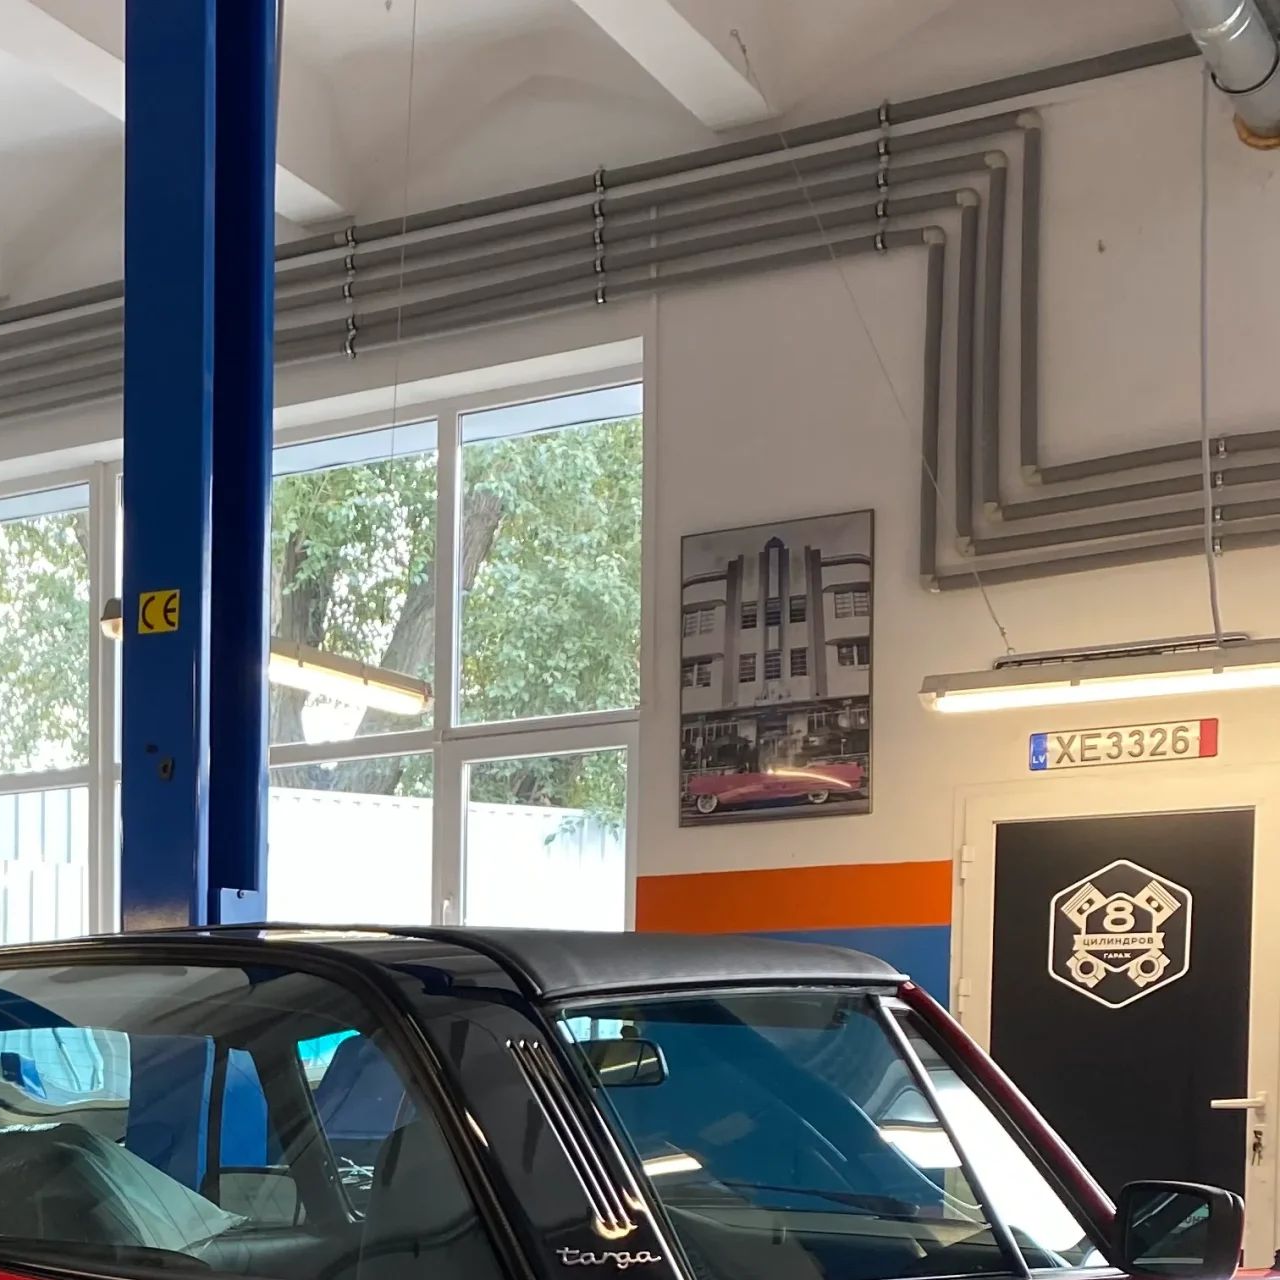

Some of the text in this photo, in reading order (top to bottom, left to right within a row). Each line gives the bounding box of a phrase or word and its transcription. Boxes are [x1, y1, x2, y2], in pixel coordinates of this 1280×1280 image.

[141, 592, 178, 630] CE
[1055, 725, 1191, 765] XE3326
[1102, 899, 1136, 933] 8
[1082, 936, 1155, 947] ЦИЛИНДРОВ
[556, 1246, 662, 1270] targa
